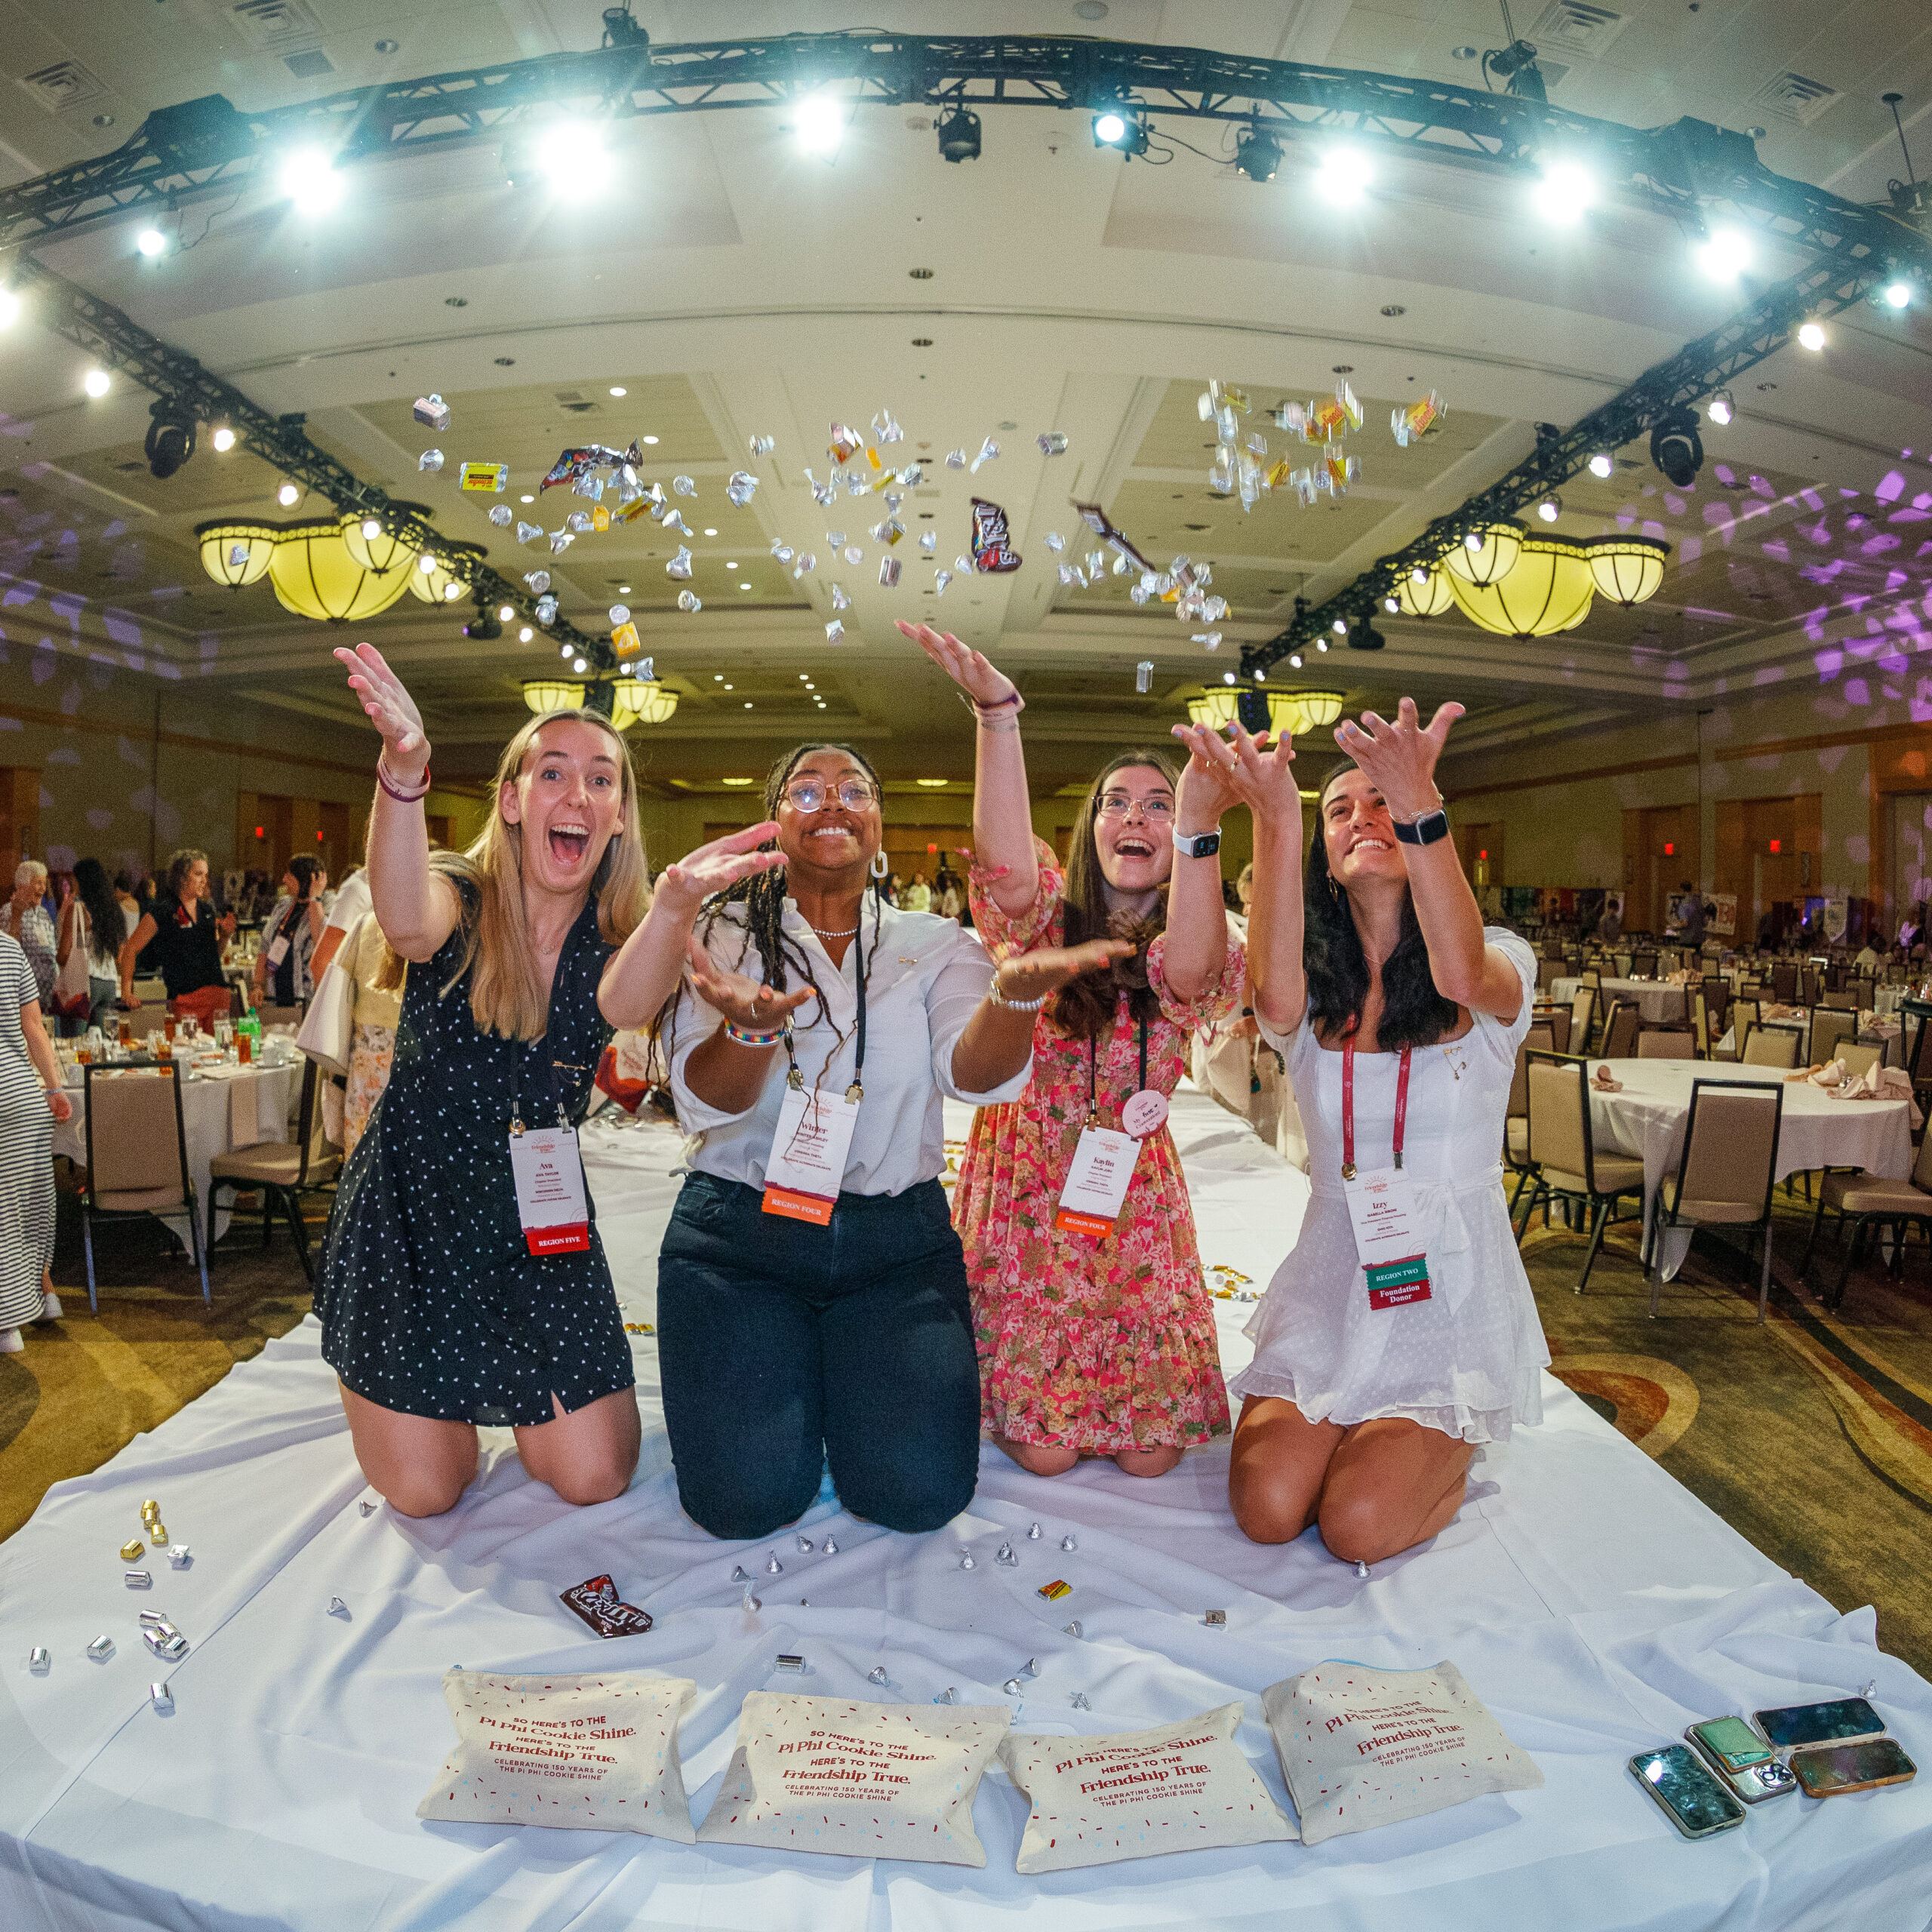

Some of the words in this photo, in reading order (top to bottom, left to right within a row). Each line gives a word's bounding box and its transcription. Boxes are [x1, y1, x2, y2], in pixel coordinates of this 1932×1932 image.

[801, 1121, 828, 1134] Winter
[771, 1198, 799, 1210] REGION
[801, 1206, 822, 1216] FOUR
[1065, 1217, 1088, 1227] REGION
[1089, 1222, 1106, 1231] FOUR
[538, 1238, 565, 1247] REGION
[1376, 1272, 1401, 1281] REGION
[1380, 1284, 1420, 1297] Foundation
[1390, 1294, 1412, 1303] Donor
[586, 1716, 606, 1725] THE
[1324, 1716, 1343, 1734] Pi
[1343, 1712, 1370, 1723] Phi
[1371, 1708, 1417, 1720] Cookie
[1372, 1721, 1404, 1731] HERE'S
[1420, 1717, 1436, 1725] THE
[531, 1727, 586, 1740] Cookie
[589, 1725, 636, 1740] Shine.
[829, 1734, 865, 1744] HERE'S
[1357, 1726, 1432, 1755] Friendship
[1433, 1723, 1465, 1734] True.
[515, 1737, 554, 1746] HERE'S
[1109, 1746, 1165, 1761] Cookie
[1168, 1736, 1217, 1750] Shine.
[489, 1741, 575, 1760] Friendship
[579, 1752, 617, 1764] True.
[826, 1743, 883, 1757] Cookie
[886, 1752, 937, 1761] Shine.
[1372, 1746, 1420, 1761] CELEBRATING
[1419, 1748, 1444, 1758] COOKIE
[1445, 1742, 1465, 1751] SHINE
[494, 1758, 549, 1770] CELEBRATING
[811, 1757, 846, 1766] HERE'S
[1101, 1762, 1139, 1774] HERE'S
[1143, 1759, 1156, 1767] TO
[1161, 1756, 1183, 1764] THE
[783, 1770, 866, 1782] Friendship
[872, 1773, 910, 1784] True.
[1080, 1769, 1168, 1794] Friendship
[1171, 1763, 1211, 1776] True.
[1093, 1789, 1149, 1802] CELEBRATING
[1146, 1792, 1177, 1800] COOKIE
